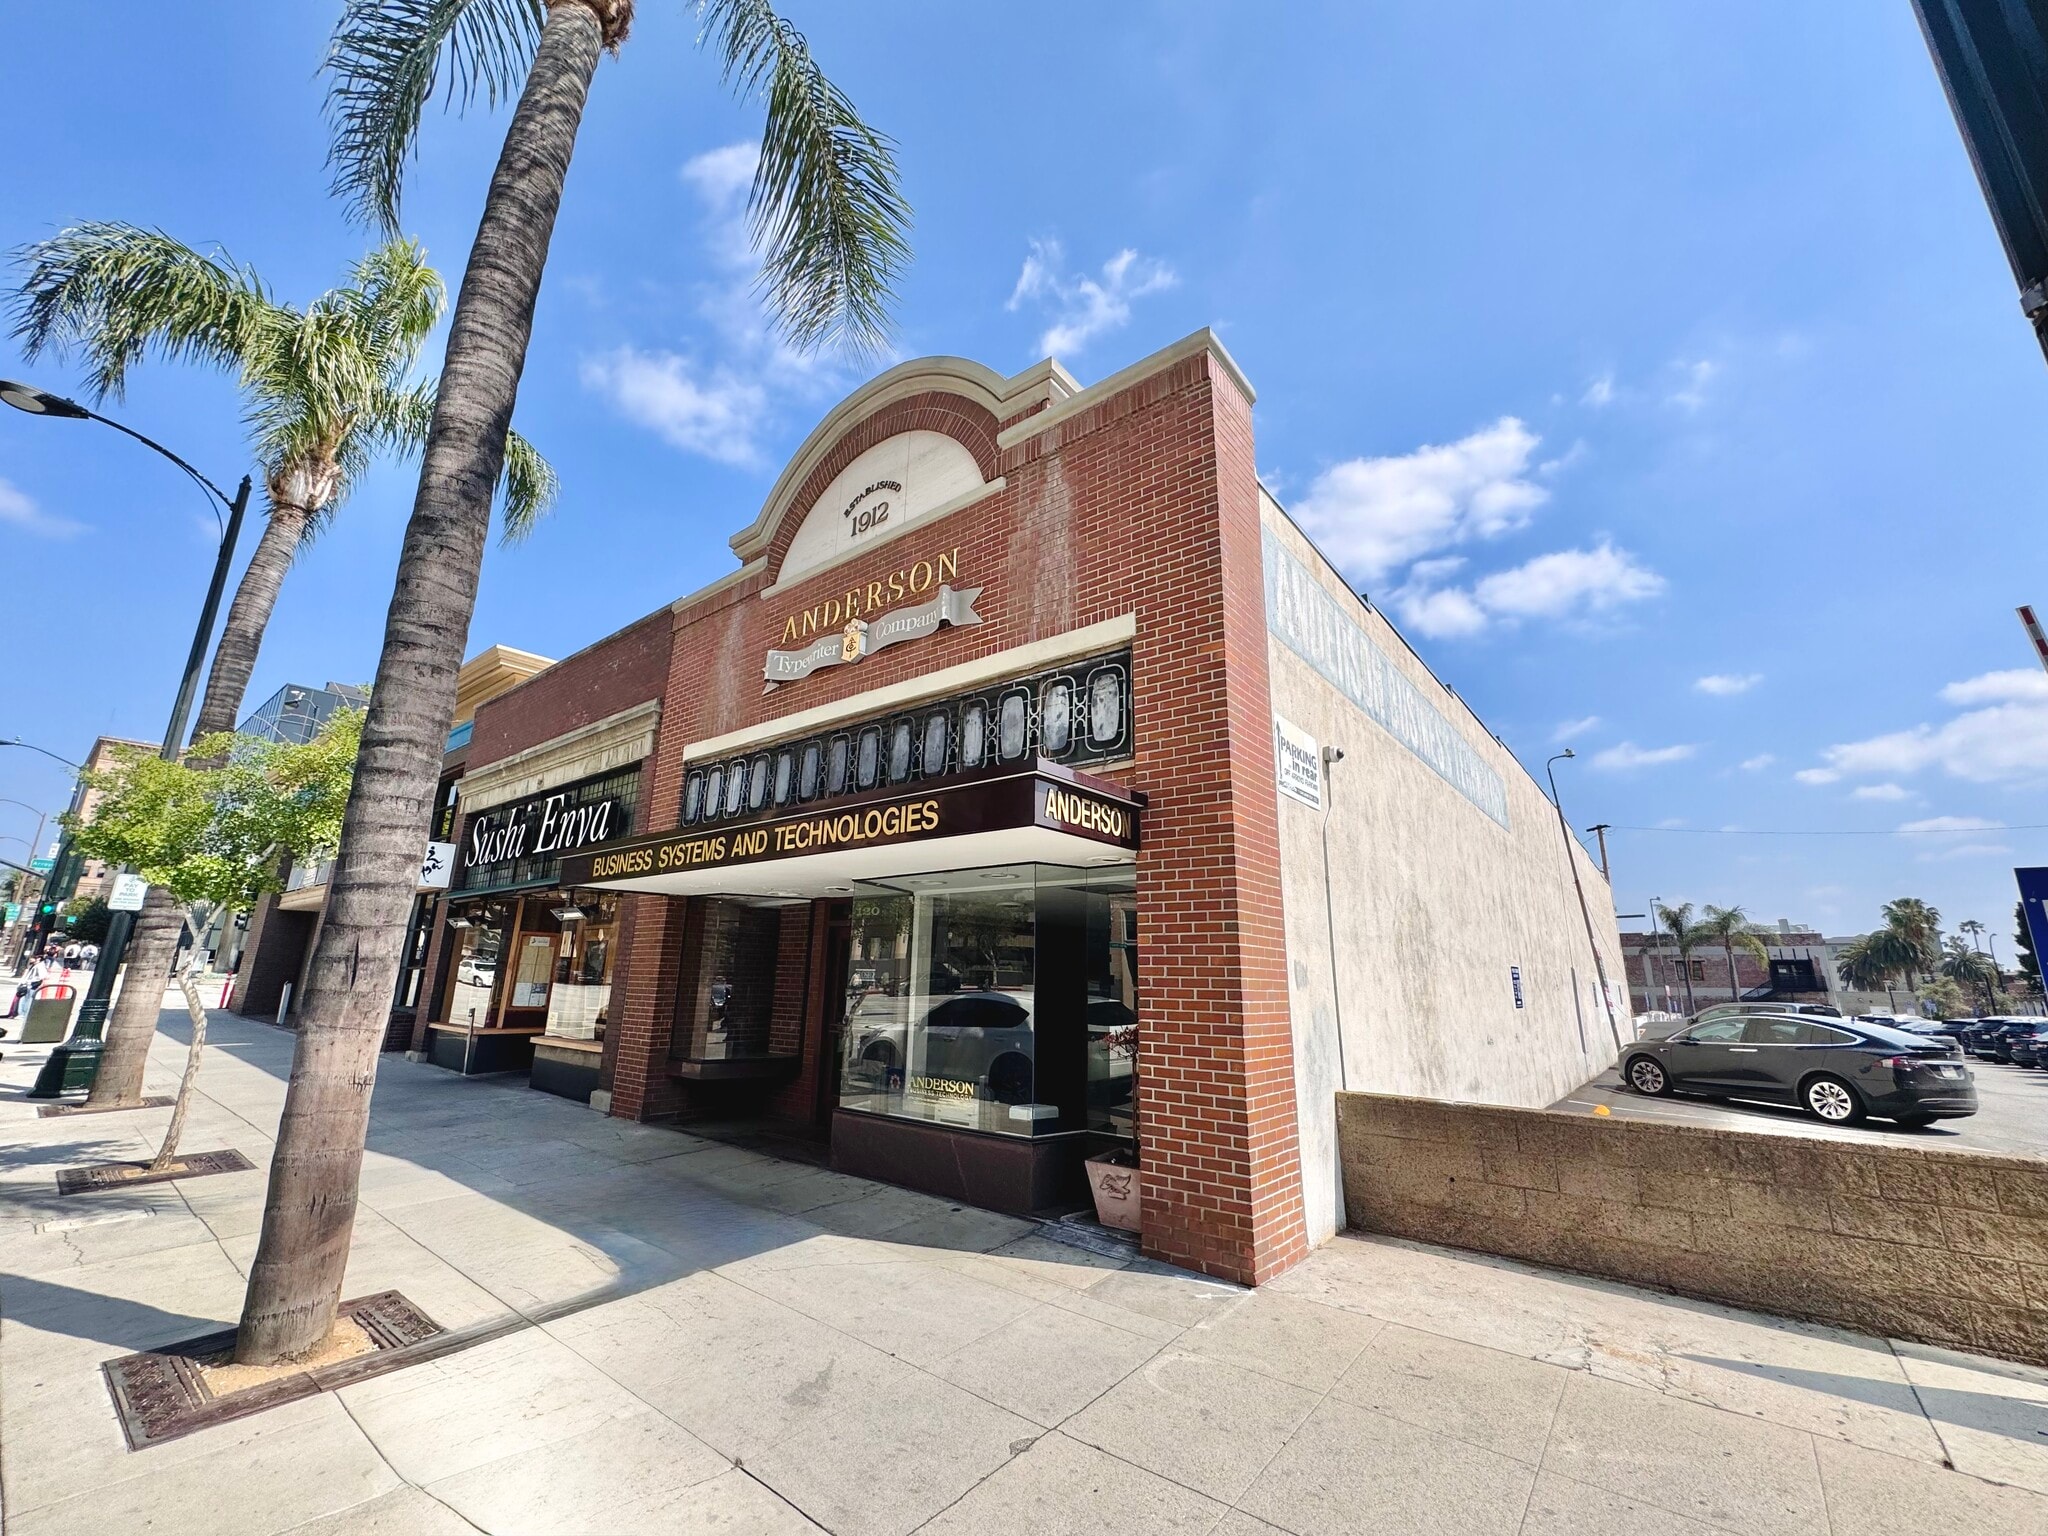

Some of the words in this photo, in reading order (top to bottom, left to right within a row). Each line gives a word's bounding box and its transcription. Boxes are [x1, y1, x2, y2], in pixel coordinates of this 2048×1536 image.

[843, 480, 902, 518] ESTABLISHED
[850, 501, 889, 537] 1912
[780, 547, 960, 645] ANDERSON
[773, 642, 840, 673] Typewriter
[1280, 735, 1318, 771] PARKING
[1292, 757, 1300, 773] in
[1302, 766, 1318, 783] rear
[1044, 788, 1132, 839] ANDERSON
[464, 804, 532, 867] Sushi
[592, 849, 653, 878] BUSINESS
[658, 835, 727, 867] SYSTEMS
[731, 829, 769, 858] AND
[774, 800, 940, 850] TECHNOLOGIES
[856, 906, 880, 916] 120
[908, 1076, 975, 1096] ANDERSON
